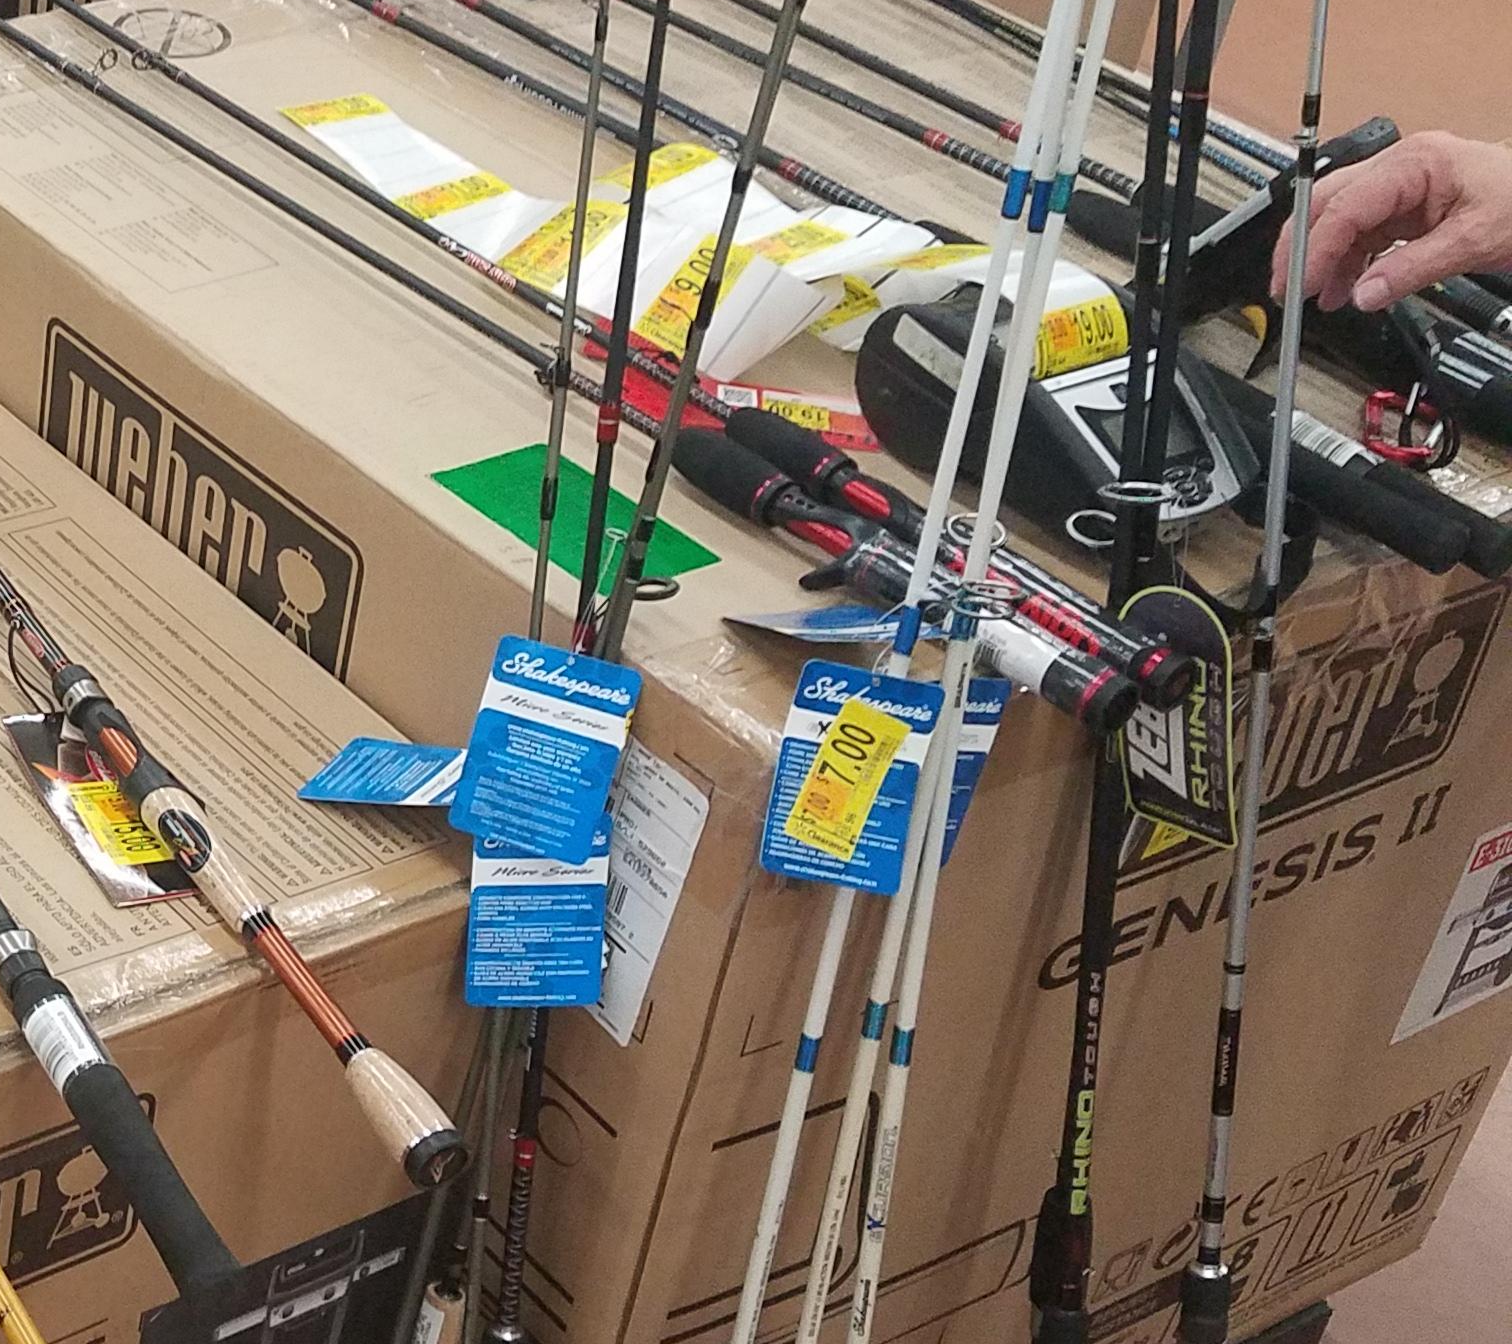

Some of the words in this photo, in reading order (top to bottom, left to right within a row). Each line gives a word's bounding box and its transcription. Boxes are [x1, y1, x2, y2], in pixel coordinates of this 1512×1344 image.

[501, 652, 632, 707] Shakespeare
[1126, 702, 1188, 800] ZEB
[1037, 813, 1384, 993] GENESIS
[1396, 784, 1453, 847] II
[1068, 1089, 1096, 1217] RHINO
